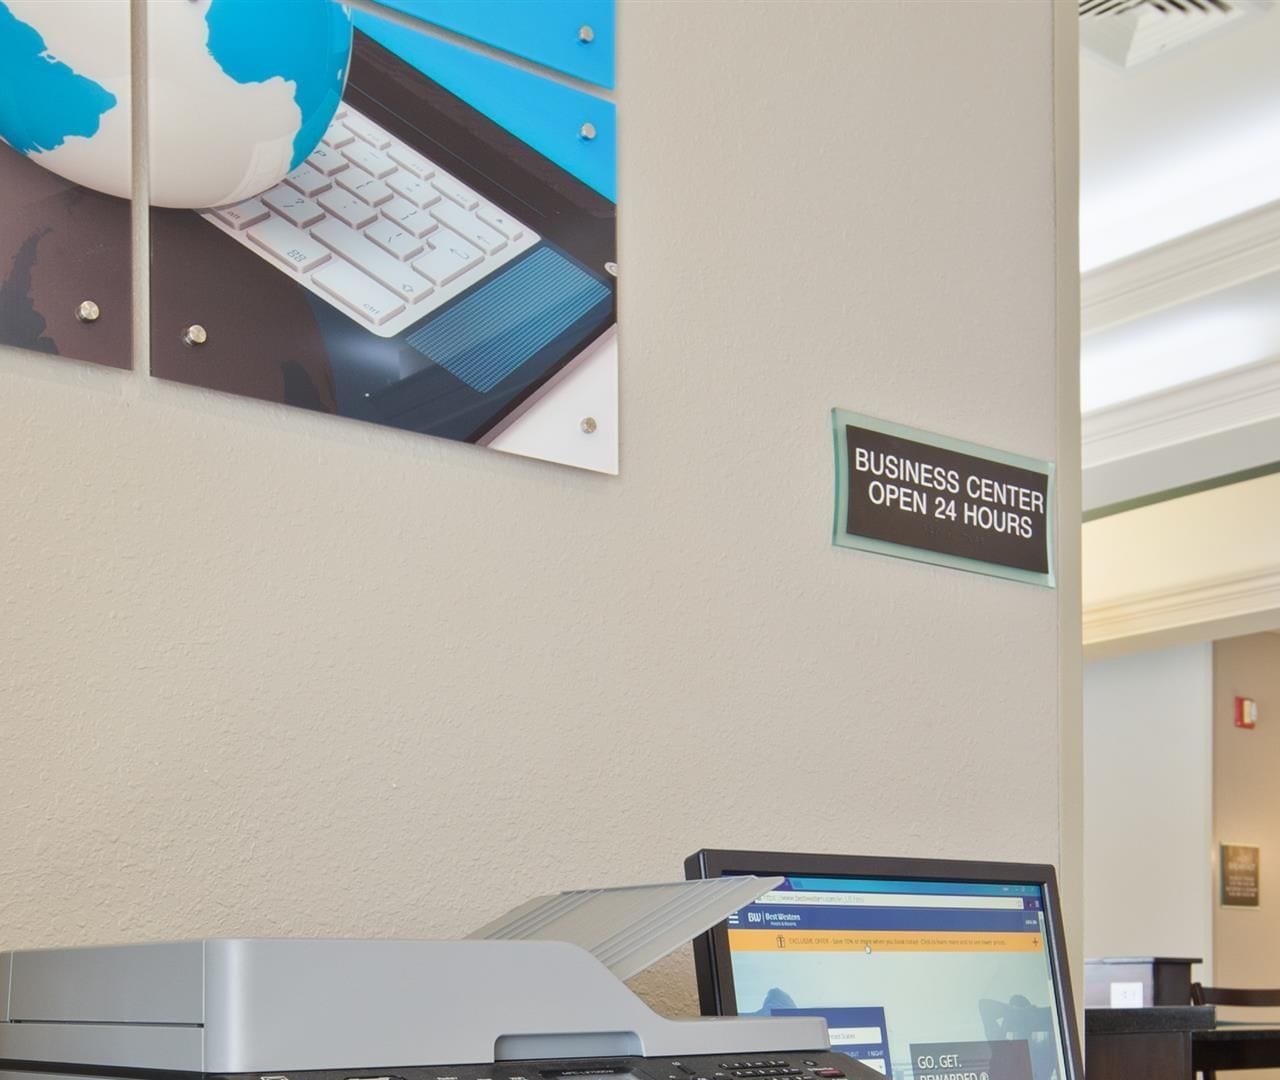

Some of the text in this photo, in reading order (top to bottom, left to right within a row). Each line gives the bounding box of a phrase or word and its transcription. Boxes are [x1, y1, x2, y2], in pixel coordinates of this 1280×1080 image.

[856, 448, 1044, 514] BUSINESS CENTER
[869, 481, 1032, 538] OPEN 24 HOURS
[765, 912, 777, 921] Best
[918, 1055, 962, 1069] GO. GET.
